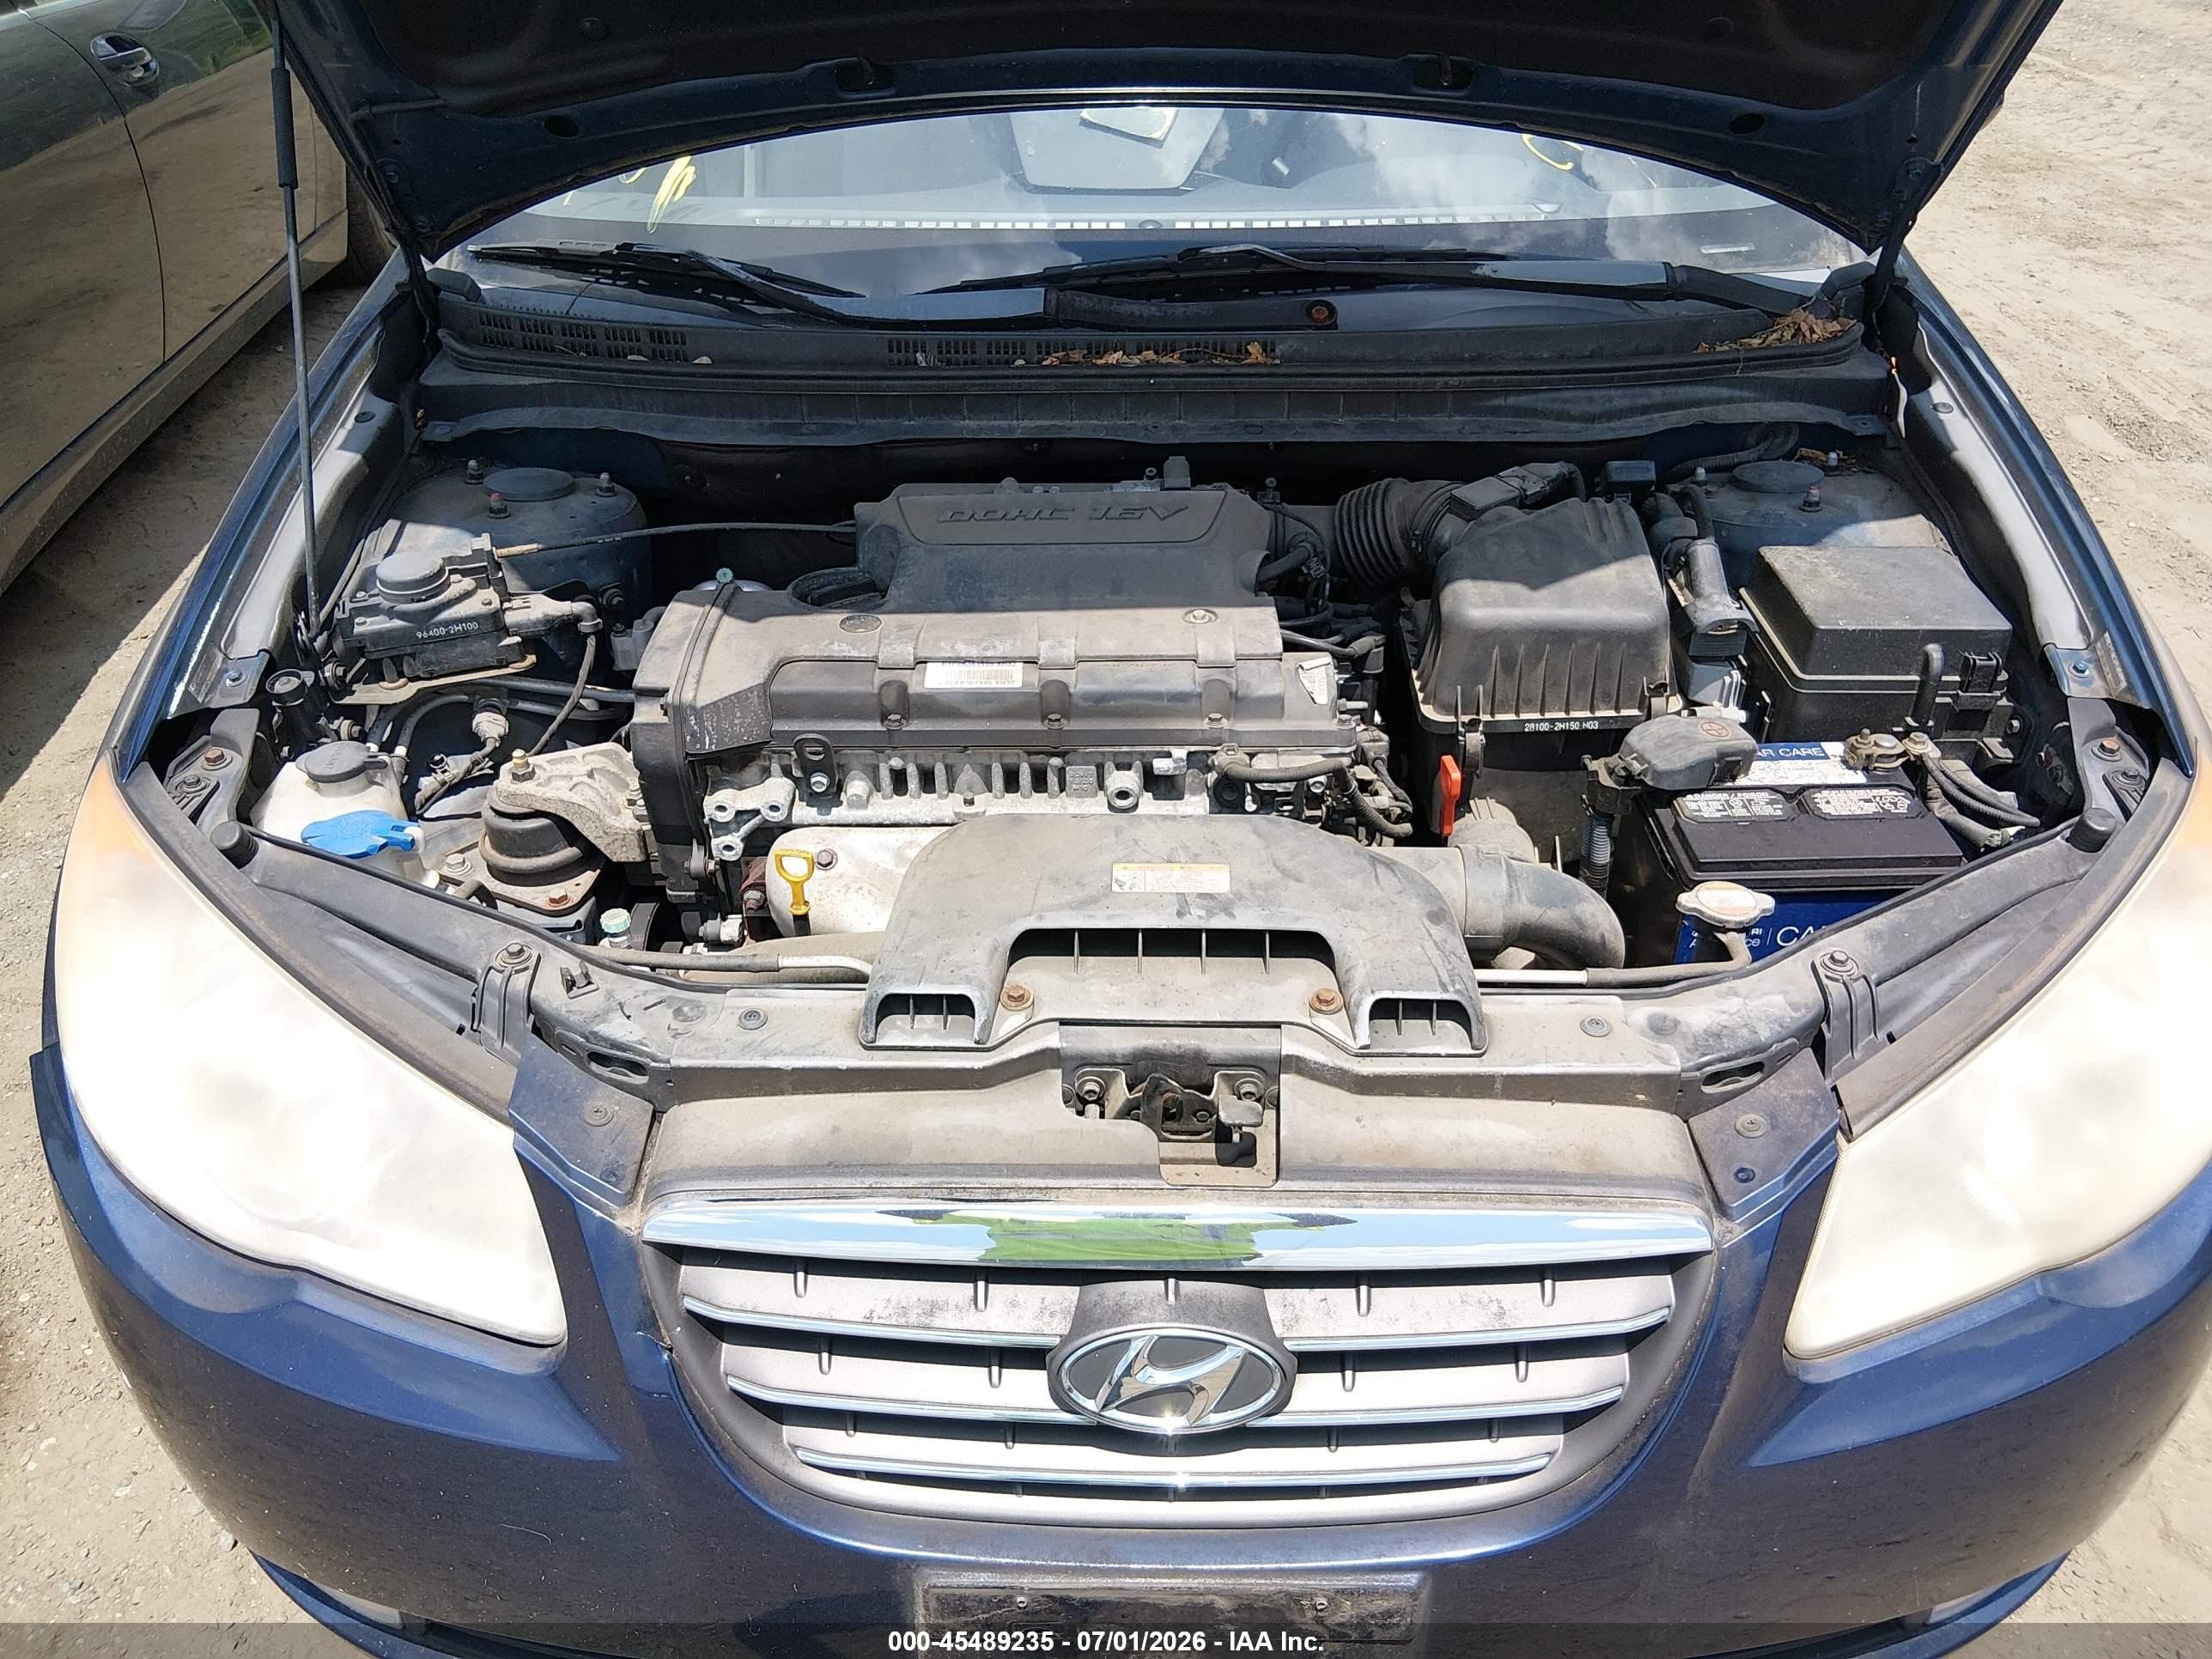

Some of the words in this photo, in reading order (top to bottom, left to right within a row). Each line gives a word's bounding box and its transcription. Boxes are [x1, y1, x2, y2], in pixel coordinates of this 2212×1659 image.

[937, 507, 1075, 523] DOHC
[1088, 505, 1190, 521] 16V
[416, 621, 479, 640] 96400-2H100
[1524, 721, 1580, 732] 28100-2H150
[1582, 720, 1599, 730] H03
[1778, 747, 1826, 757] CARE
